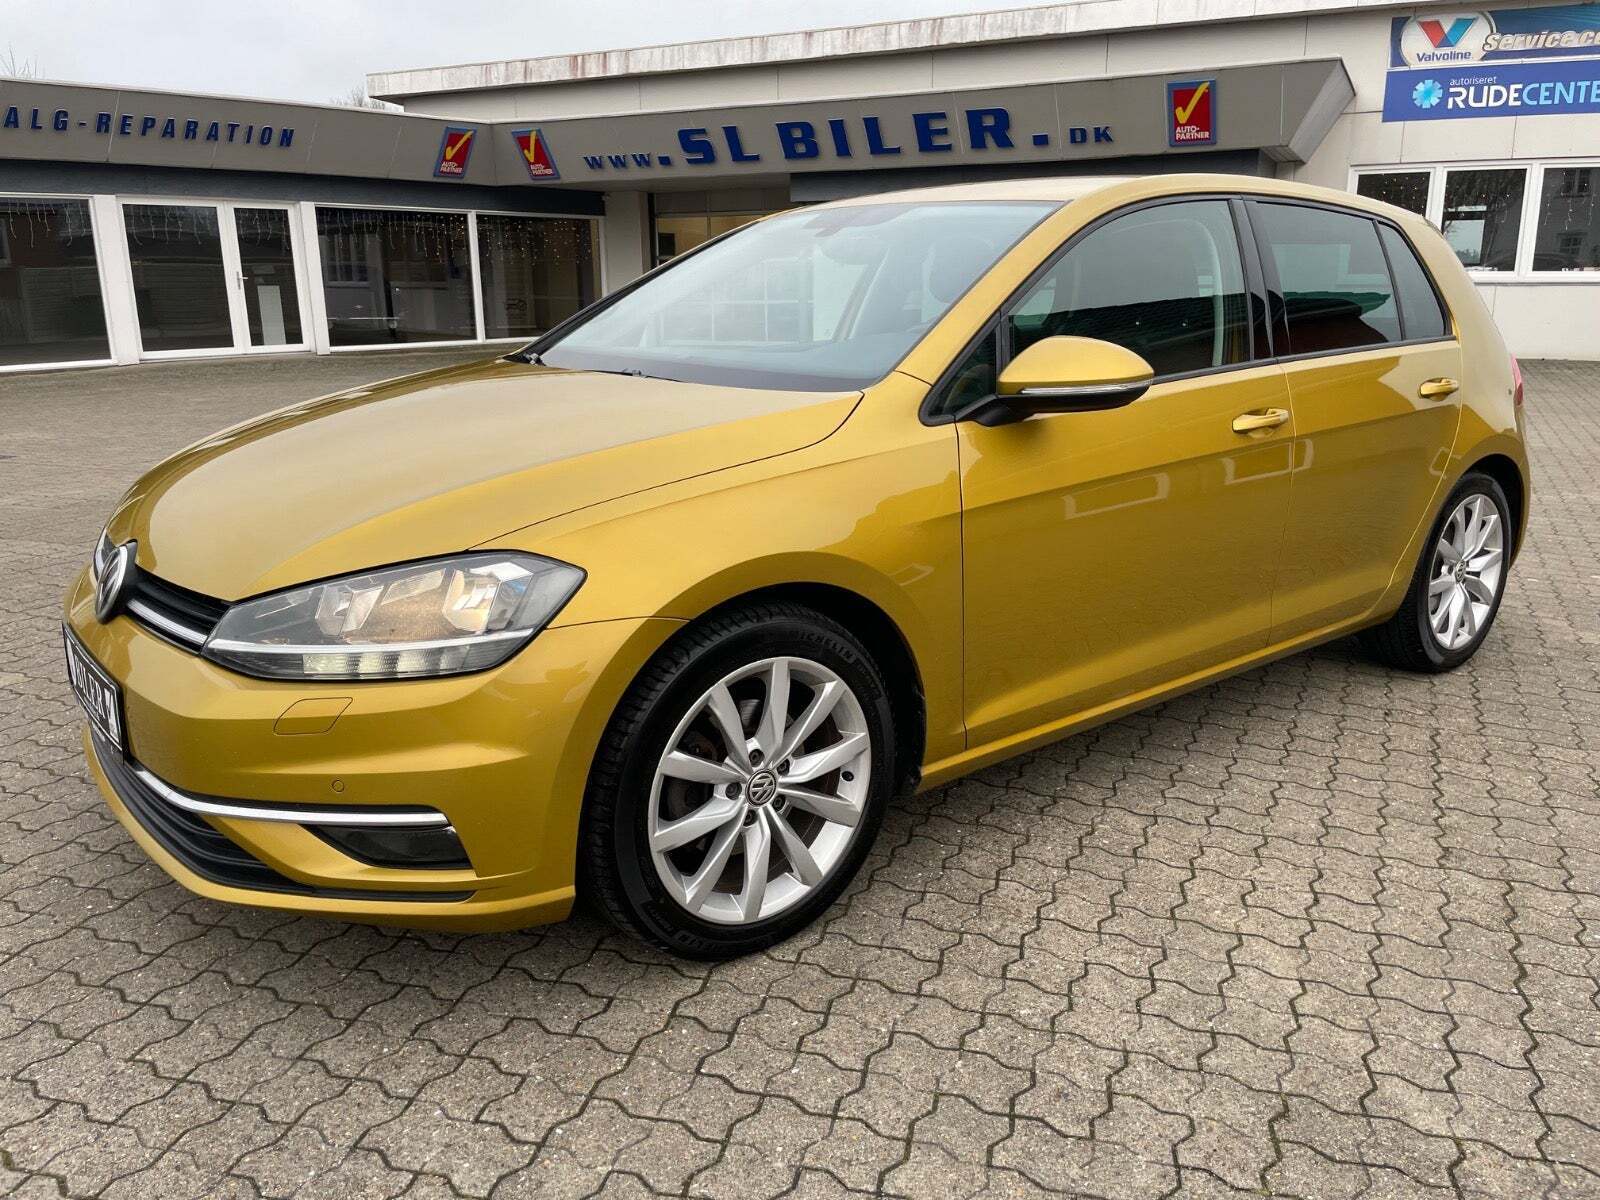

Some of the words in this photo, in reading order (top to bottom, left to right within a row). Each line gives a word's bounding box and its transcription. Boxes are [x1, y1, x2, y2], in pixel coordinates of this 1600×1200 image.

[1416, 51, 1472, 62] Valvoline
[1449, 76, 1497, 86] autoriseret
[1175, 132, 1209, 141] PARTNER
